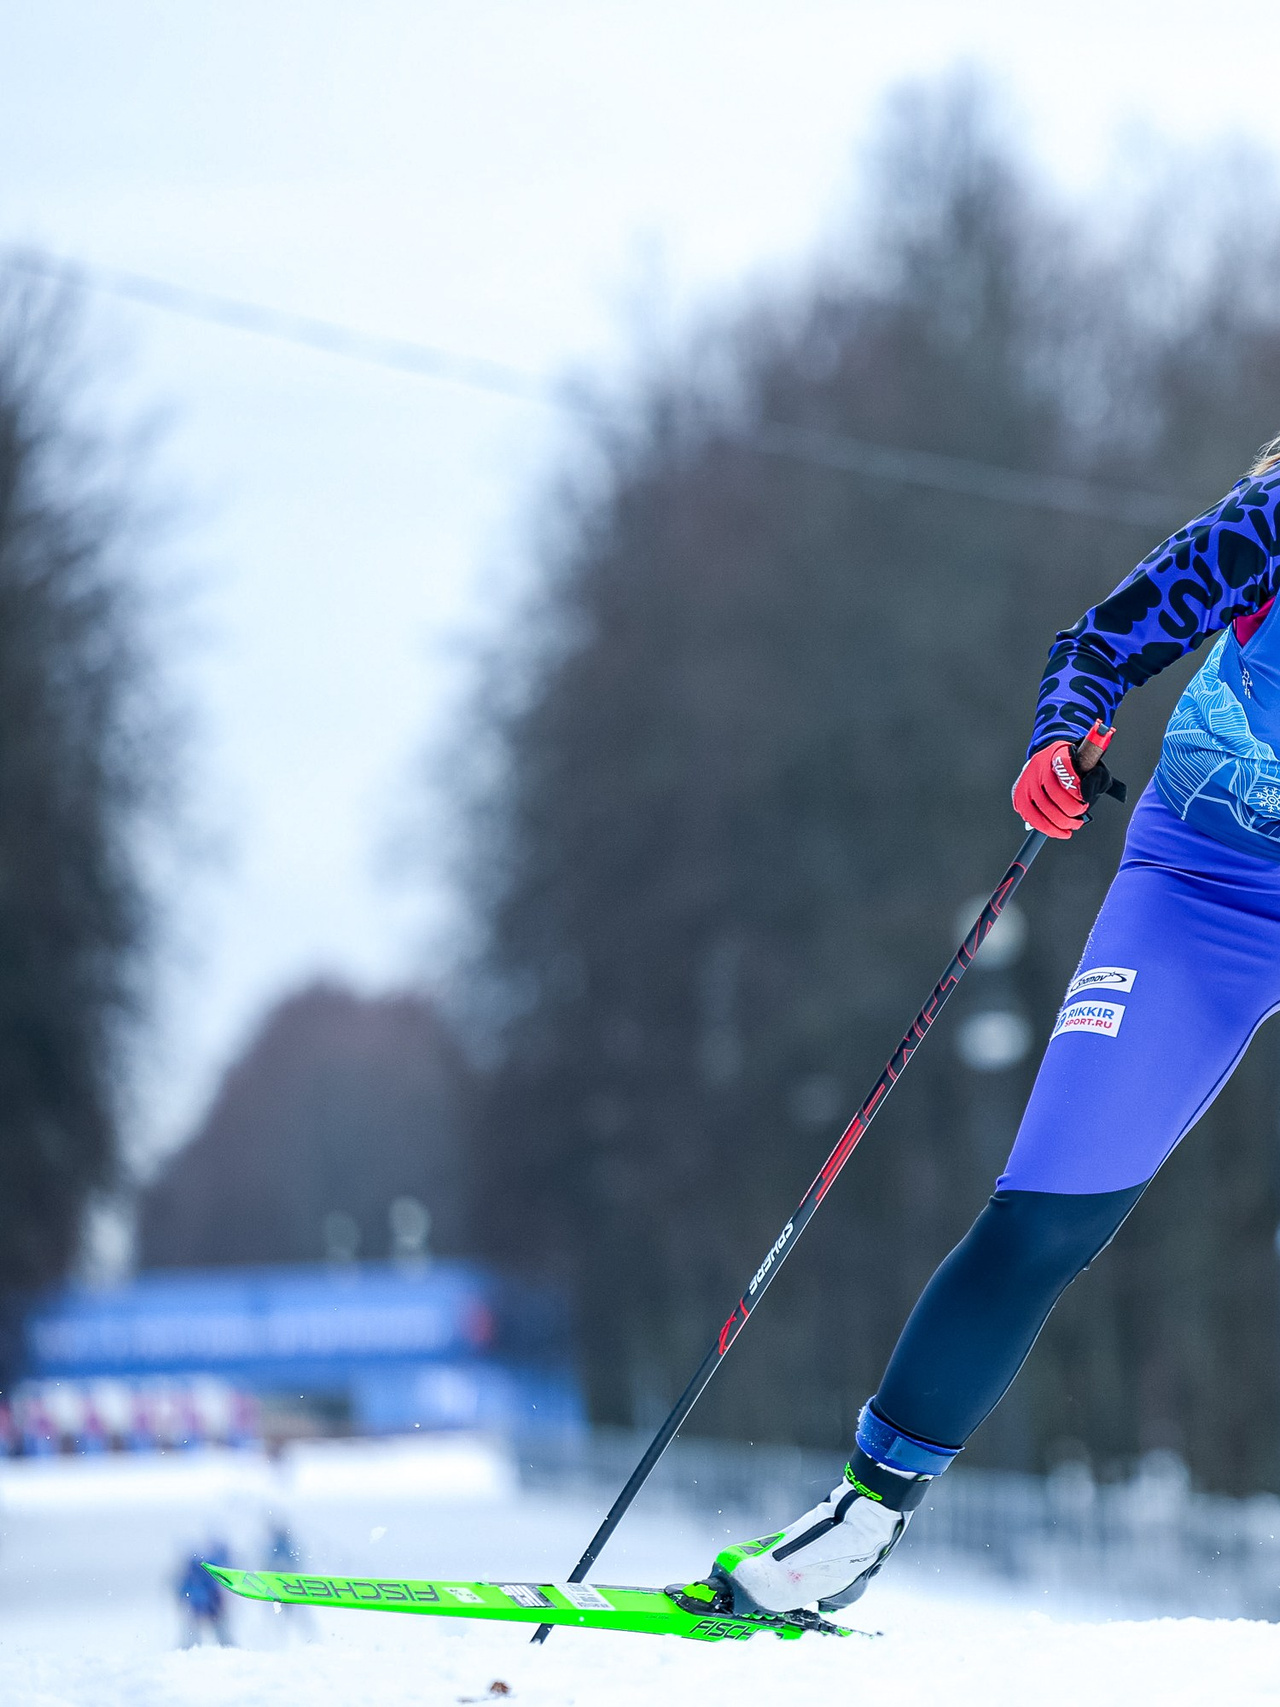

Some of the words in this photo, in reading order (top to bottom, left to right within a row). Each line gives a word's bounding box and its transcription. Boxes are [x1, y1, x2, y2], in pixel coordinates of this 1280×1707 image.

[1067, 1006, 1115, 1020] RIKKIR
[1064, 1018, 1113, 1029] SPORT.RU
[275, 1577, 442, 1602] FISCHER
